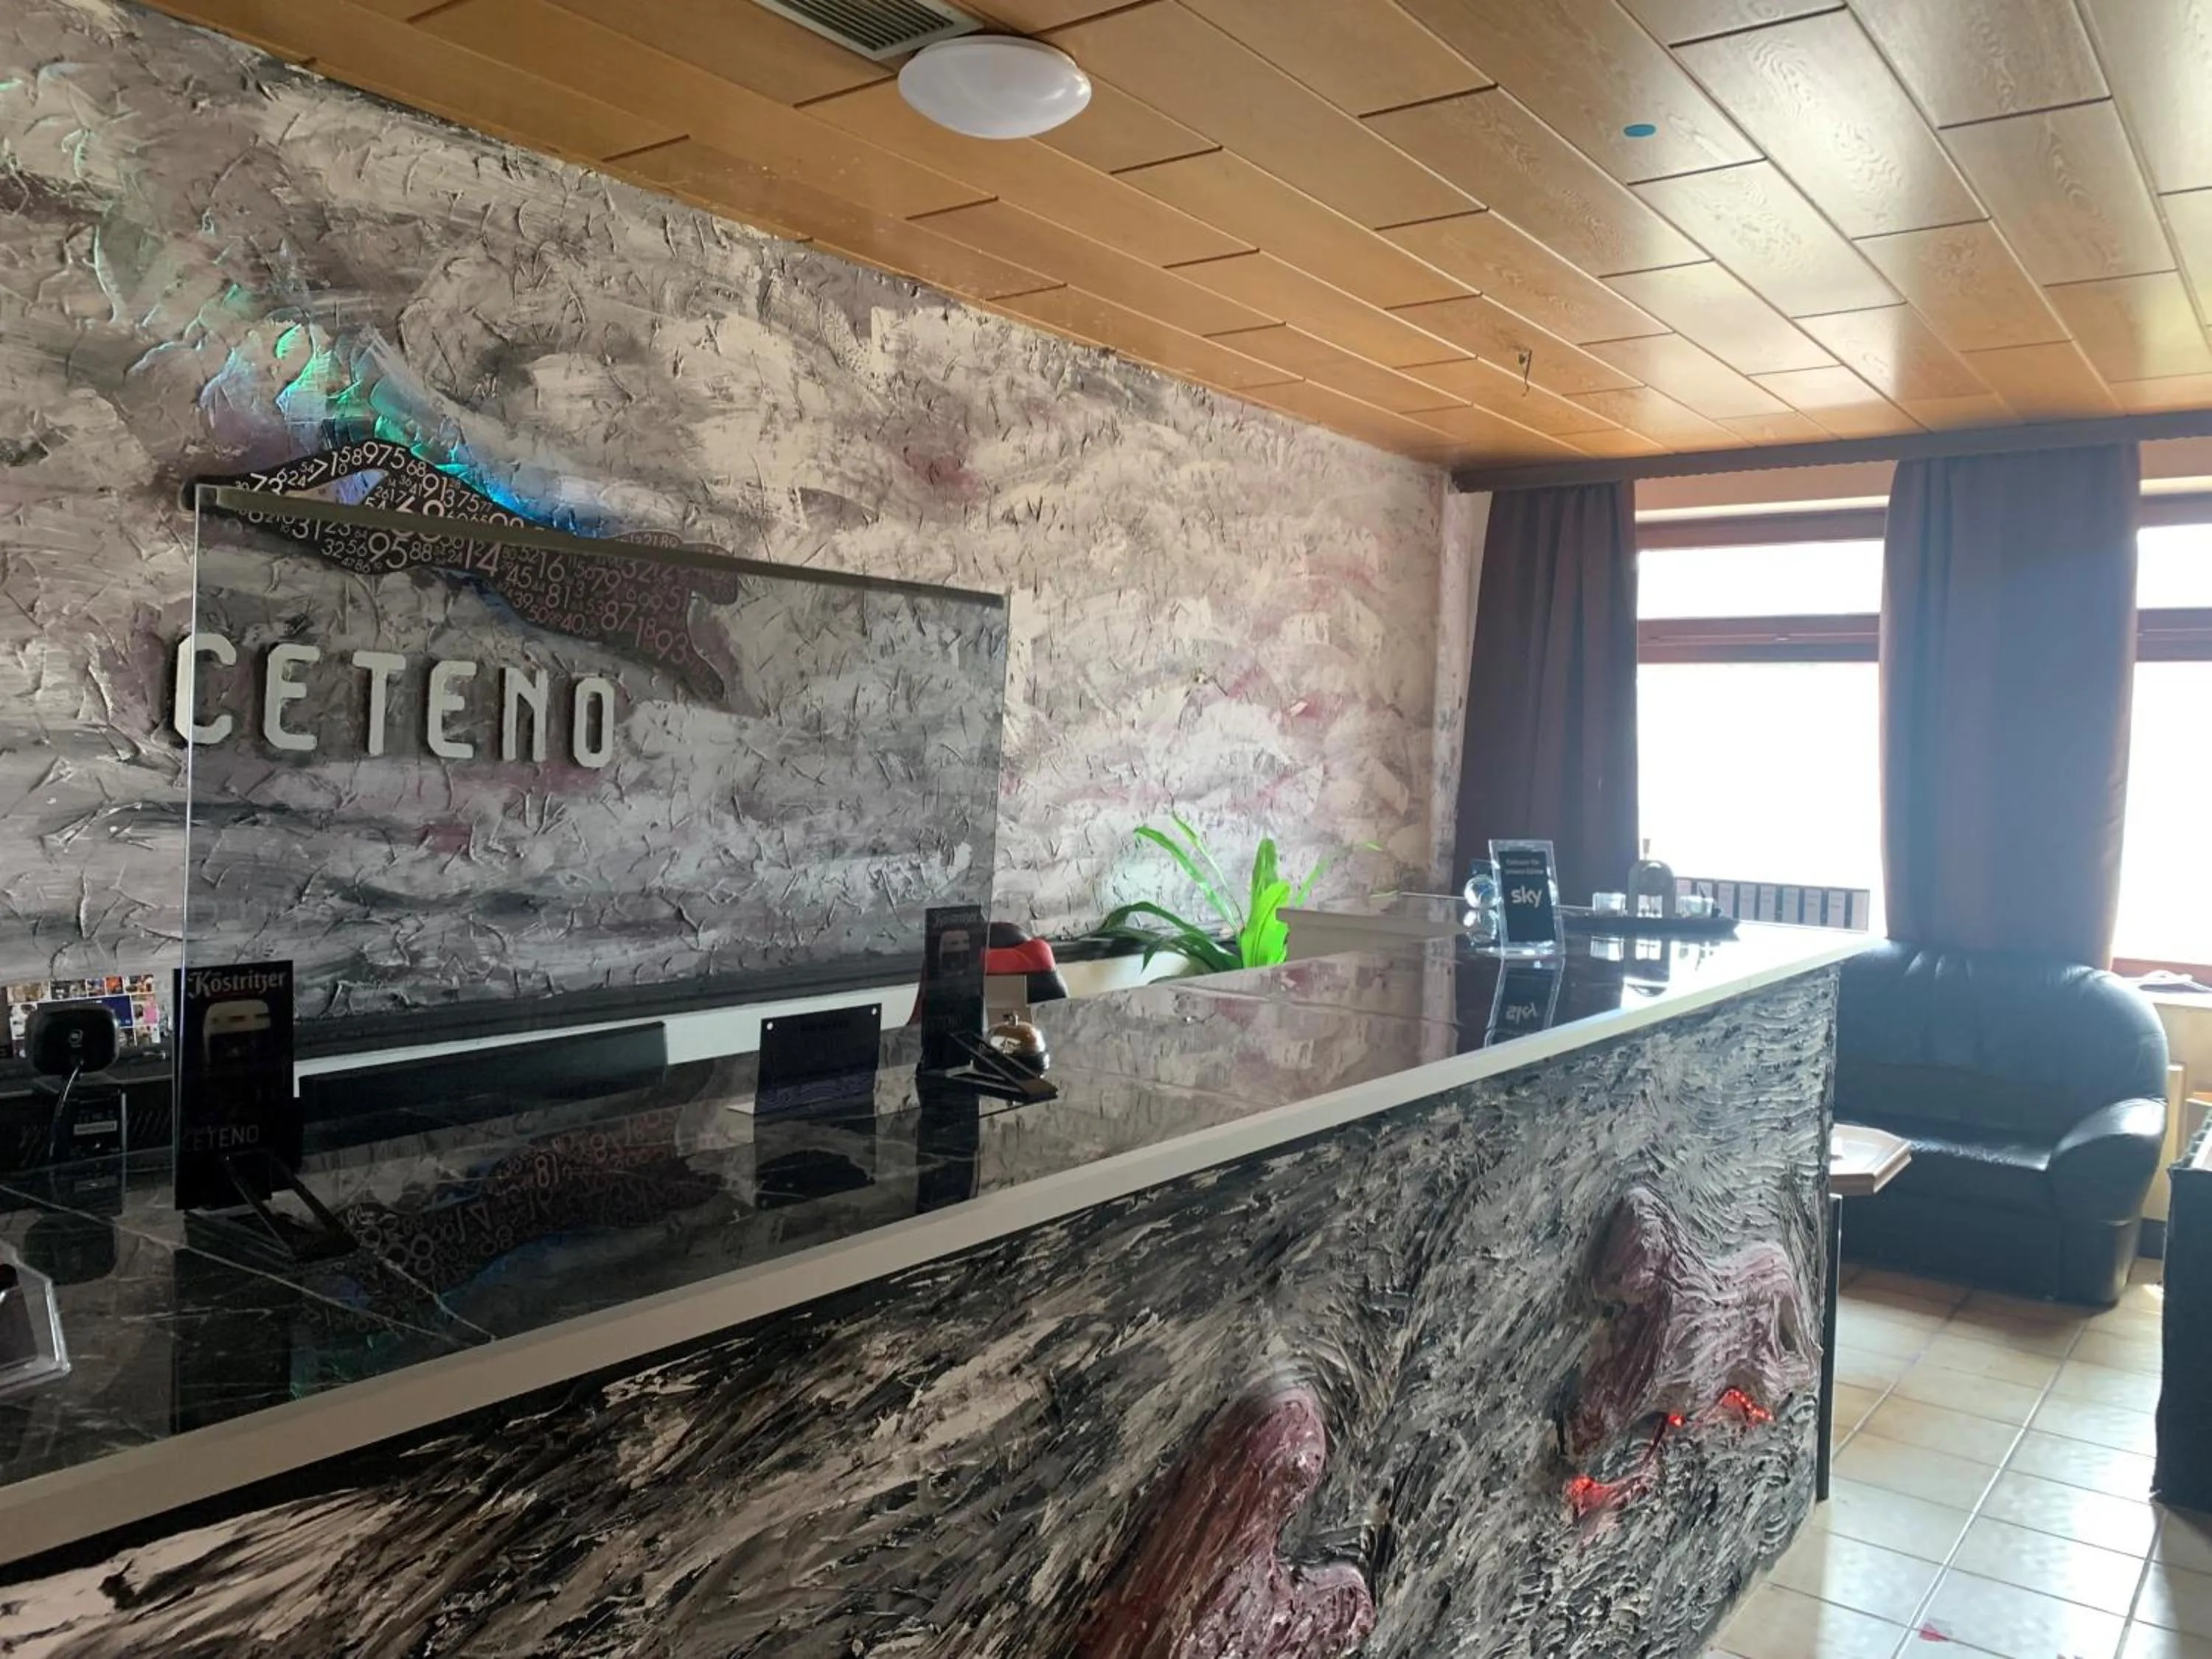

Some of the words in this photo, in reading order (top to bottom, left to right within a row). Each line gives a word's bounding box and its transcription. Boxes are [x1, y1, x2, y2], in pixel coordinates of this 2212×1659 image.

[339, 445, 363, 466] 58
[406, 459, 426, 478] 68
[369, 532, 409, 568] 95
[409, 540, 434, 563] 88
[505, 564, 533, 588] 45
[538, 552, 566, 582] 16
[512, 591, 535, 609] 39
[545, 583, 571, 609] 81
[601, 599, 638, 633] 87
[173, 632, 616, 769] CETENO
[1511, 884, 1543, 908] sky
